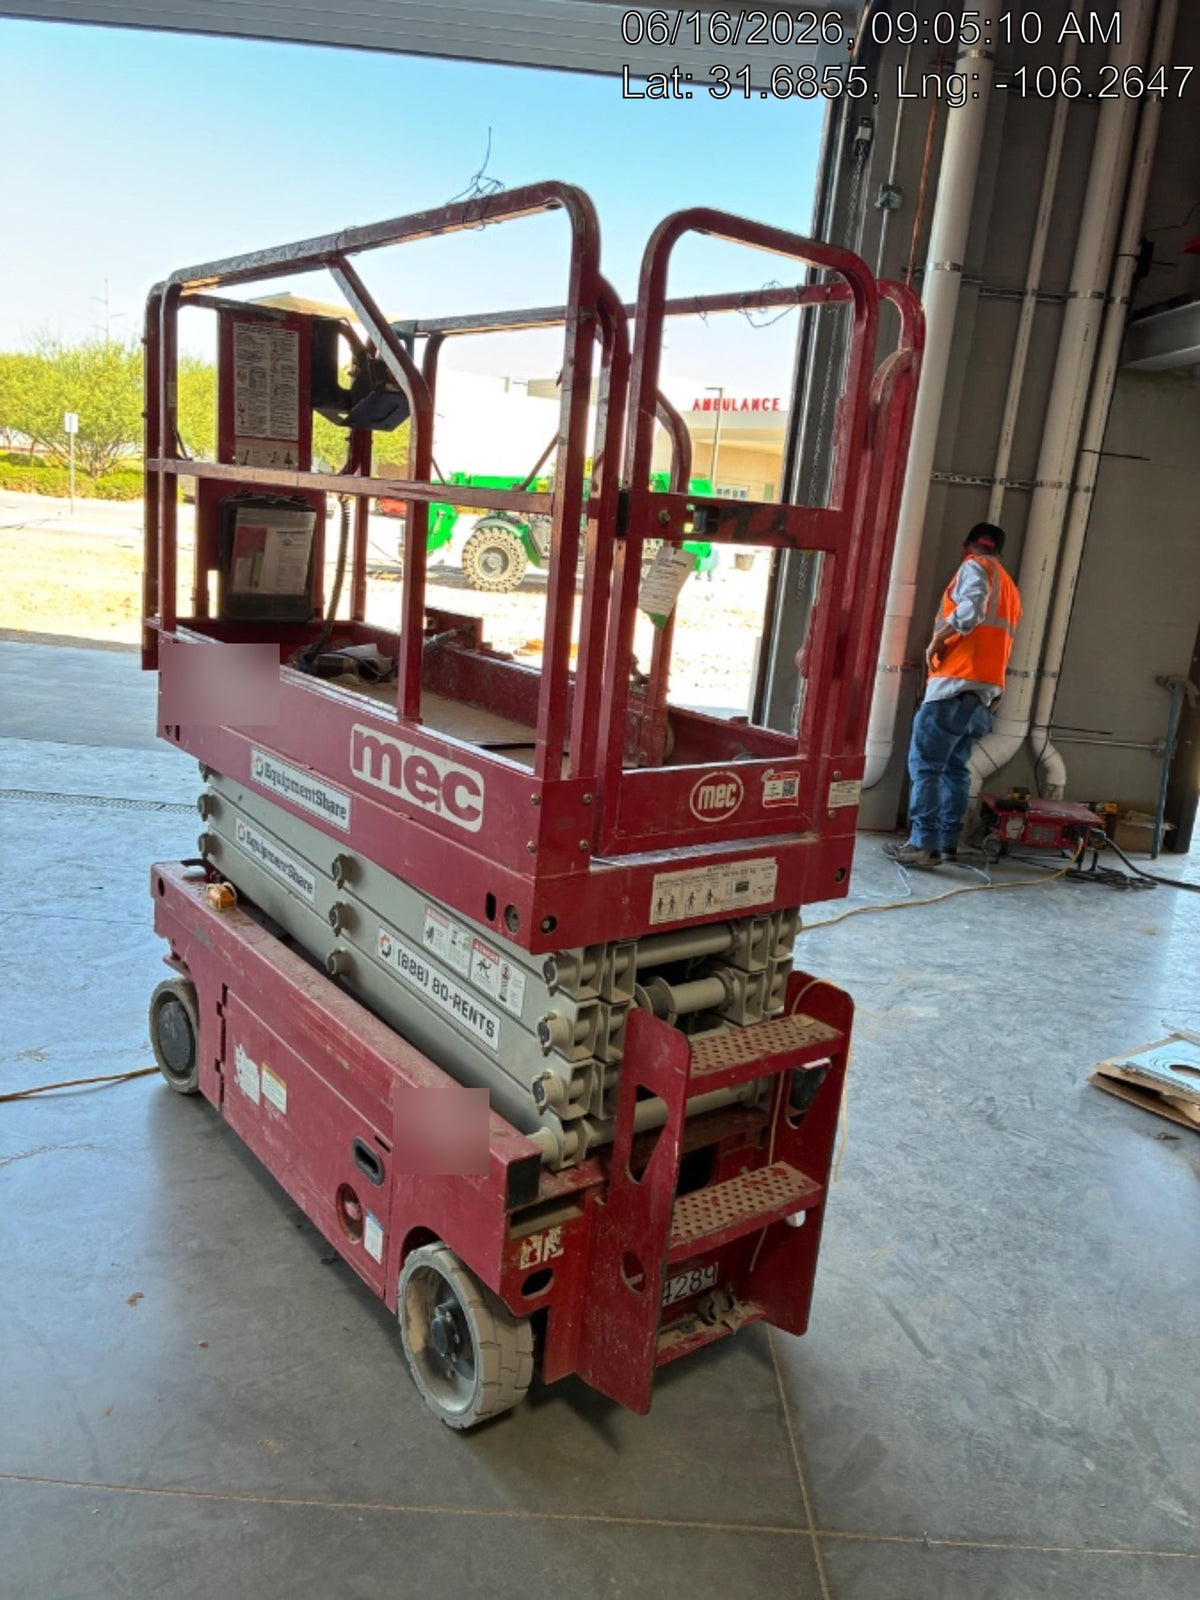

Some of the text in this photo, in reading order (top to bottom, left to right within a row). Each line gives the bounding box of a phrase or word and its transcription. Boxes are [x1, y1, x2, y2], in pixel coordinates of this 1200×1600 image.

[692, 398, 780, 412] AMBULANCE
[264, 762, 347, 820] EquipmentShare
[397, 949, 429, 986] (888)
[432, 976, 495, 1038] 80-RENTS
